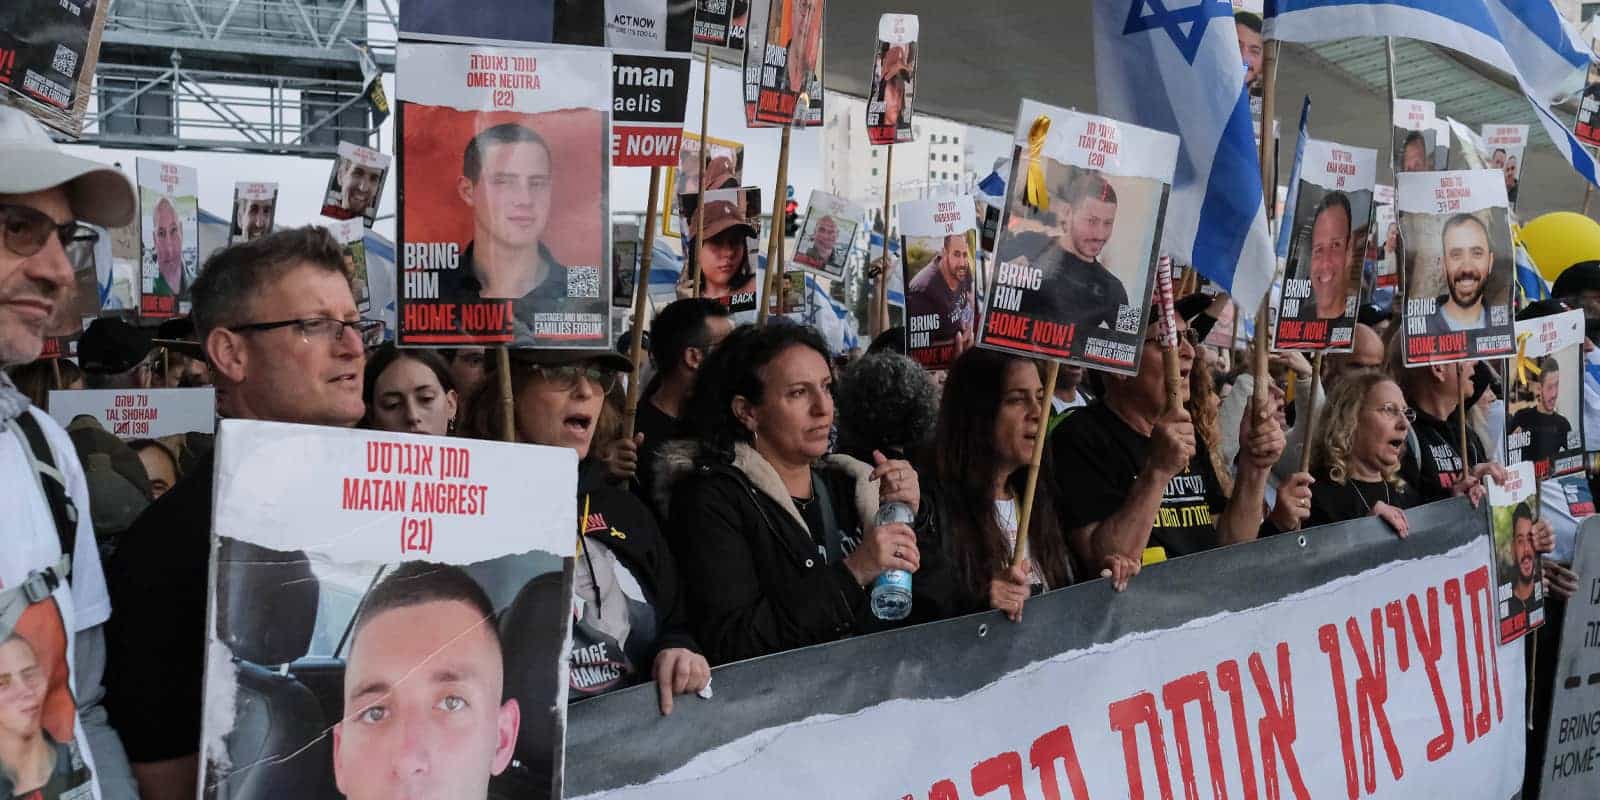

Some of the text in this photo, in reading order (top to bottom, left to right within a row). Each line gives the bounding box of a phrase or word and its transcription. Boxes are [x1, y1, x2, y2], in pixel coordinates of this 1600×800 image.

[614, 14, 656, 29] ACT NOW
[470, 54, 537, 72] עומר נאוטרה
[466, 72, 541, 90] OMER NEUTRA
[492, 89, 515, 108] (22)
[626, 135, 678, 157] NOW!
[1078, 134, 1119, 155] ITAY CHEN
[1087, 151, 1105, 169] (20)
[404, 242, 459, 269] BRING
[404, 271, 440, 299] HIM
[998, 261, 1043, 291] BRING
[1285, 279, 1312, 298] BRING
[731, 292, 753, 306] BACK
[992, 286, 1023, 312] HIM
[1281, 299, 1300, 318] HIM
[1407, 297, 1436, 317] BRING
[404, 300, 513, 331] HOME NOW!
[910, 314, 940, 332] BRING
[534, 322, 602, 336] FAMILIES FORUM
[988, 311, 1076, 348] HOME NOW!
[1279, 321, 1303, 340] HOME
[1303, 320, 1328, 340] NOW!
[1408, 316, 1427, 336] HIM
[910, 331, 930, 349] HIM
[1408, 336, 1438, 356] HOME
[1439, 330, 1468, 354] NOW!
[115, 394, 148, 407] טל שהם
[105, 408, 158, 421] TAL SHOHAM
[367, 441, 470, 481] מתן אנגרסט
[342, 477, 489, 516] MATAN ANGREST
[400, 516, 433, 554] (21)
[571, 662, 621, 689] HAMAS
[1558, 711, 1600, 744] BRING
